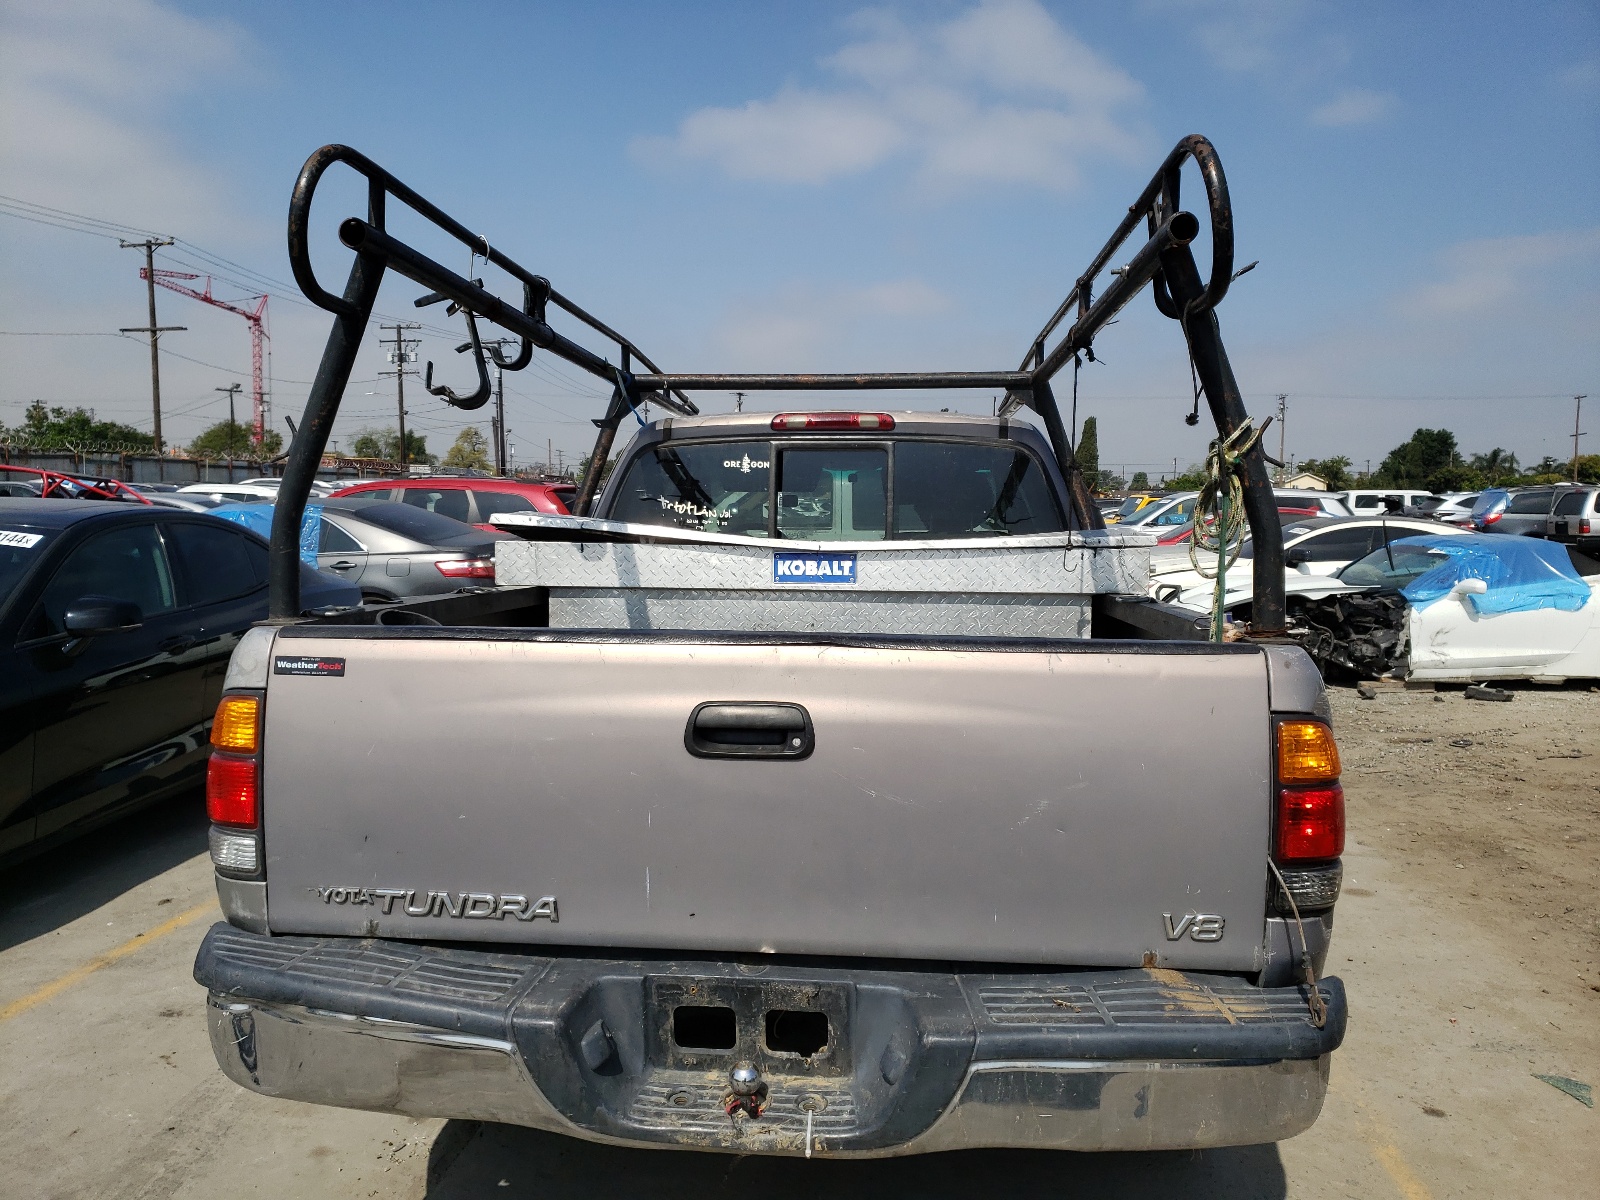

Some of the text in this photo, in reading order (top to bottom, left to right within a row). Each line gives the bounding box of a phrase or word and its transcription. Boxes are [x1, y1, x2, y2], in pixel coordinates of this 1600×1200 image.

[777, 559, 853, 576] KOBALT
[277, 660, 342, 670] WeatherTech
[375, 889, 559, 922] TUNDRA
[1163, 912, 1225, 942] V8
